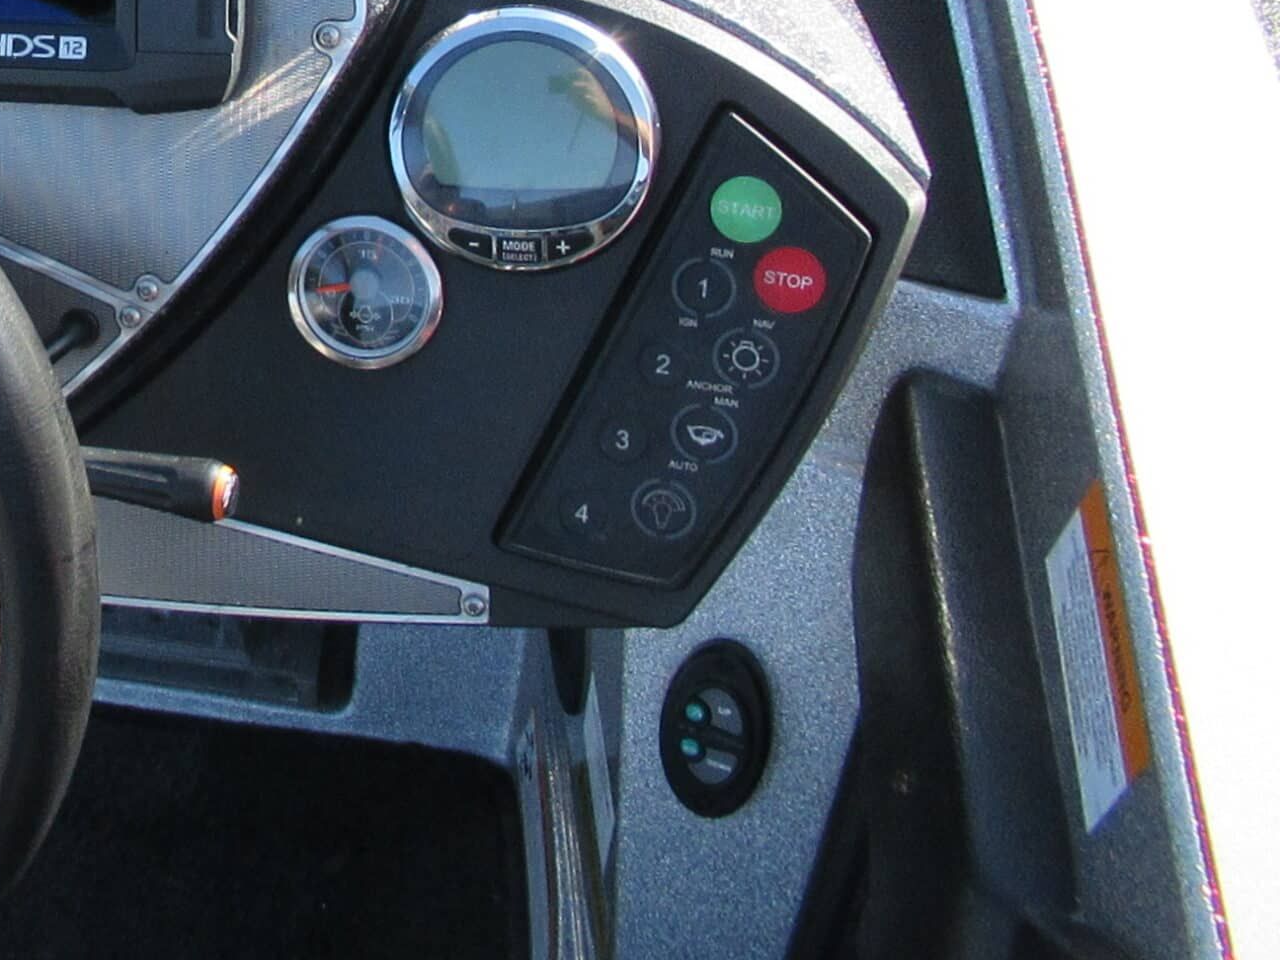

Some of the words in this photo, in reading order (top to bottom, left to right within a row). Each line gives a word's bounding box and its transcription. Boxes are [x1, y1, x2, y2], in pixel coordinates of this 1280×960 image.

[61, 38, 86, 58] 12
[718, 199, 776, 218] START
[502, 240, 536, 252] MODE
[710, 247, 734, 260] RUN
[697, 277, 708, 299] 1
[763, 269, 813, 291] STOP
[655, 353, 671, 376] 2
[686, 379, 733, 395] ANCHOR
[714, 396, 739, 409] MAN
[615, 429, 629, 451] 3
[668, 460, 698, 472] AUTO
[574, 503, 589, 524] 4
